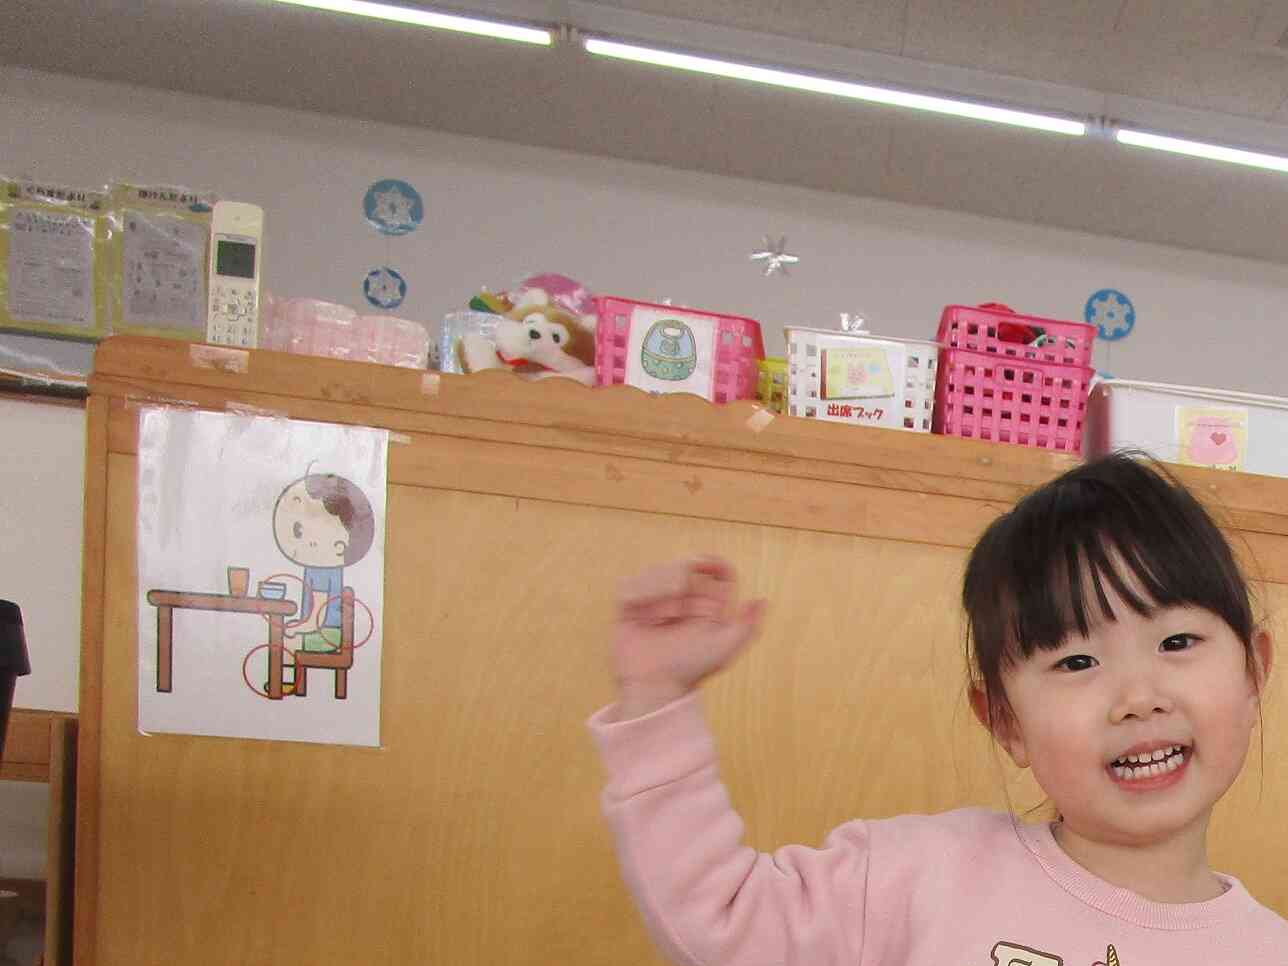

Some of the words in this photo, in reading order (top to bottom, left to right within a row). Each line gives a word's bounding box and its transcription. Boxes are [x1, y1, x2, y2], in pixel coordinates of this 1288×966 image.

[827, 403, 884, 420] 出席ブック
